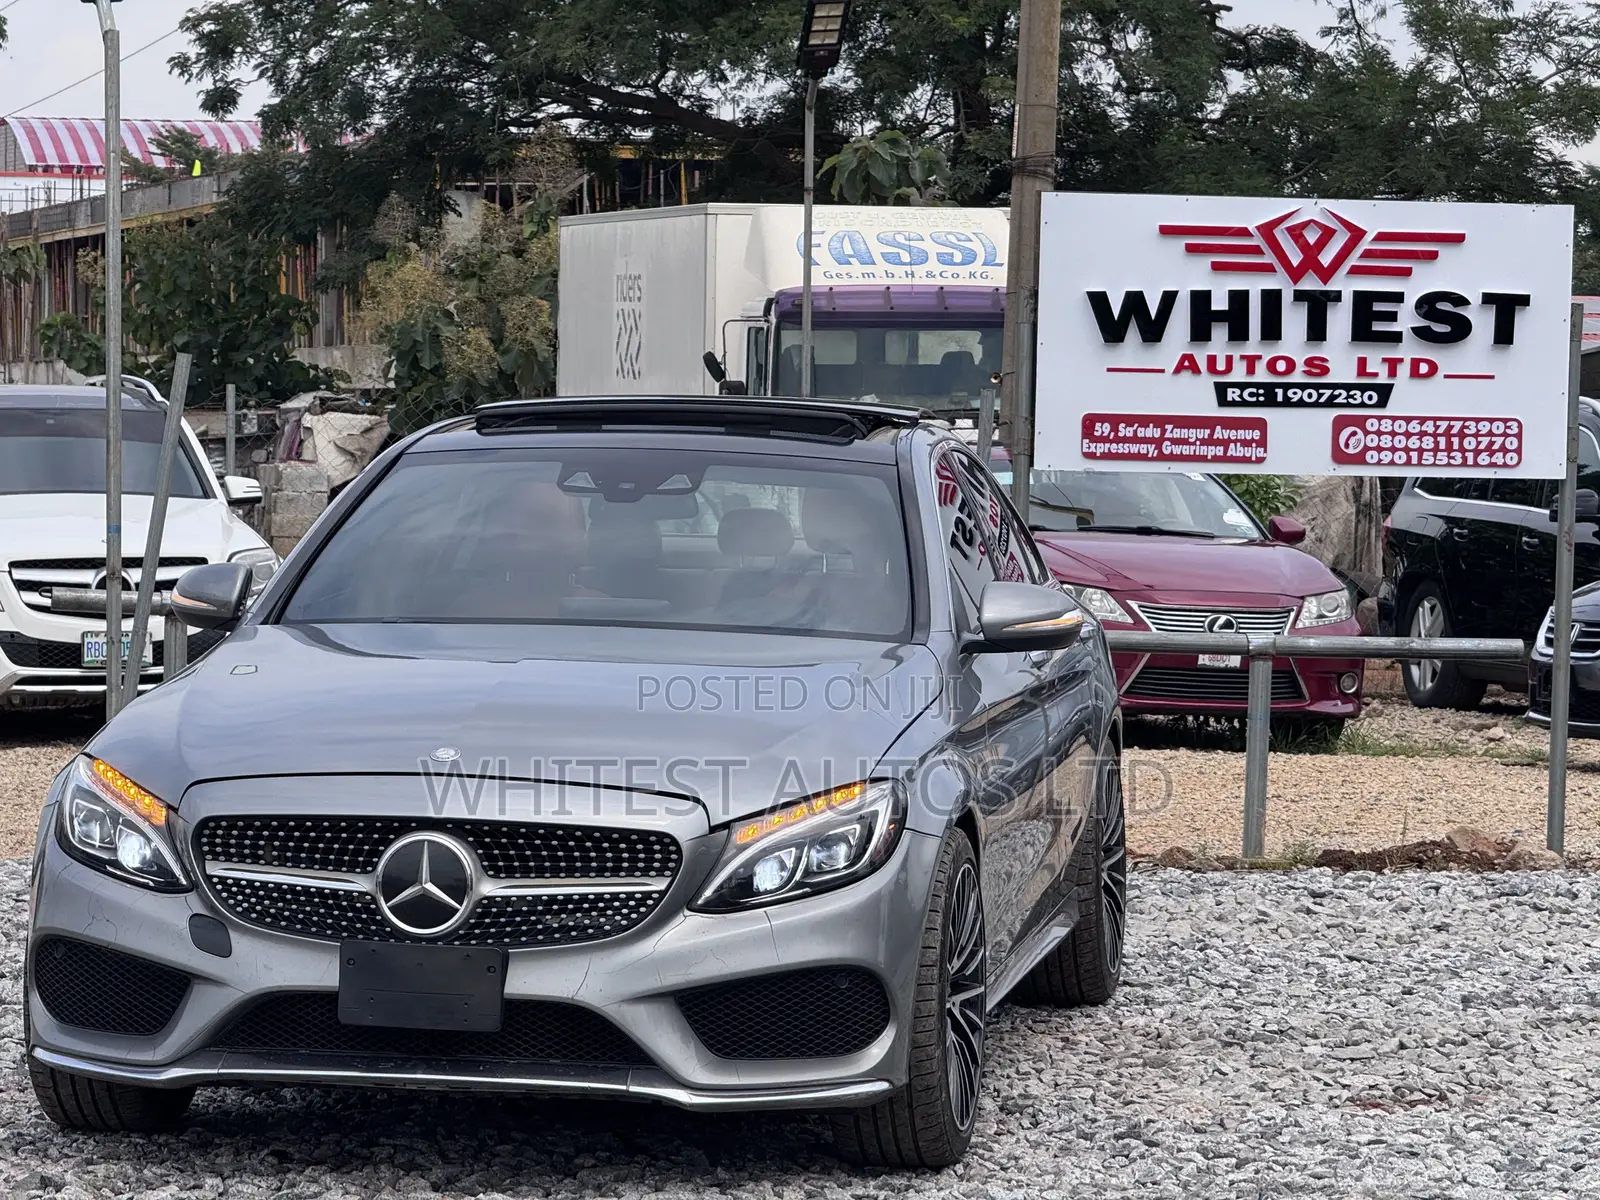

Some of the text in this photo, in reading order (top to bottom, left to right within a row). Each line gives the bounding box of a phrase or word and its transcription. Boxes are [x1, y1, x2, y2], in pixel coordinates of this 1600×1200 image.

[1085, 289, 1531, 346] WHITEST
[1171, 353, 1439, 379] AUTOS LTD
[1227, 387, 1379, 405] RC: 1907230
[1094, 422, 1115, 439] 59,
[1164, 424, 1210, 442] Zangur
[1213, 425, 1261, 440] Avenue
[1365, 418, 1519, 434] 08064773903
[1082, 439, 1268, 461] Expressway, Gwarinpa Abuja.
[1365, 433, 1519, 450] 08068110770
[1365, 450, 1519, 465] 09015531640
